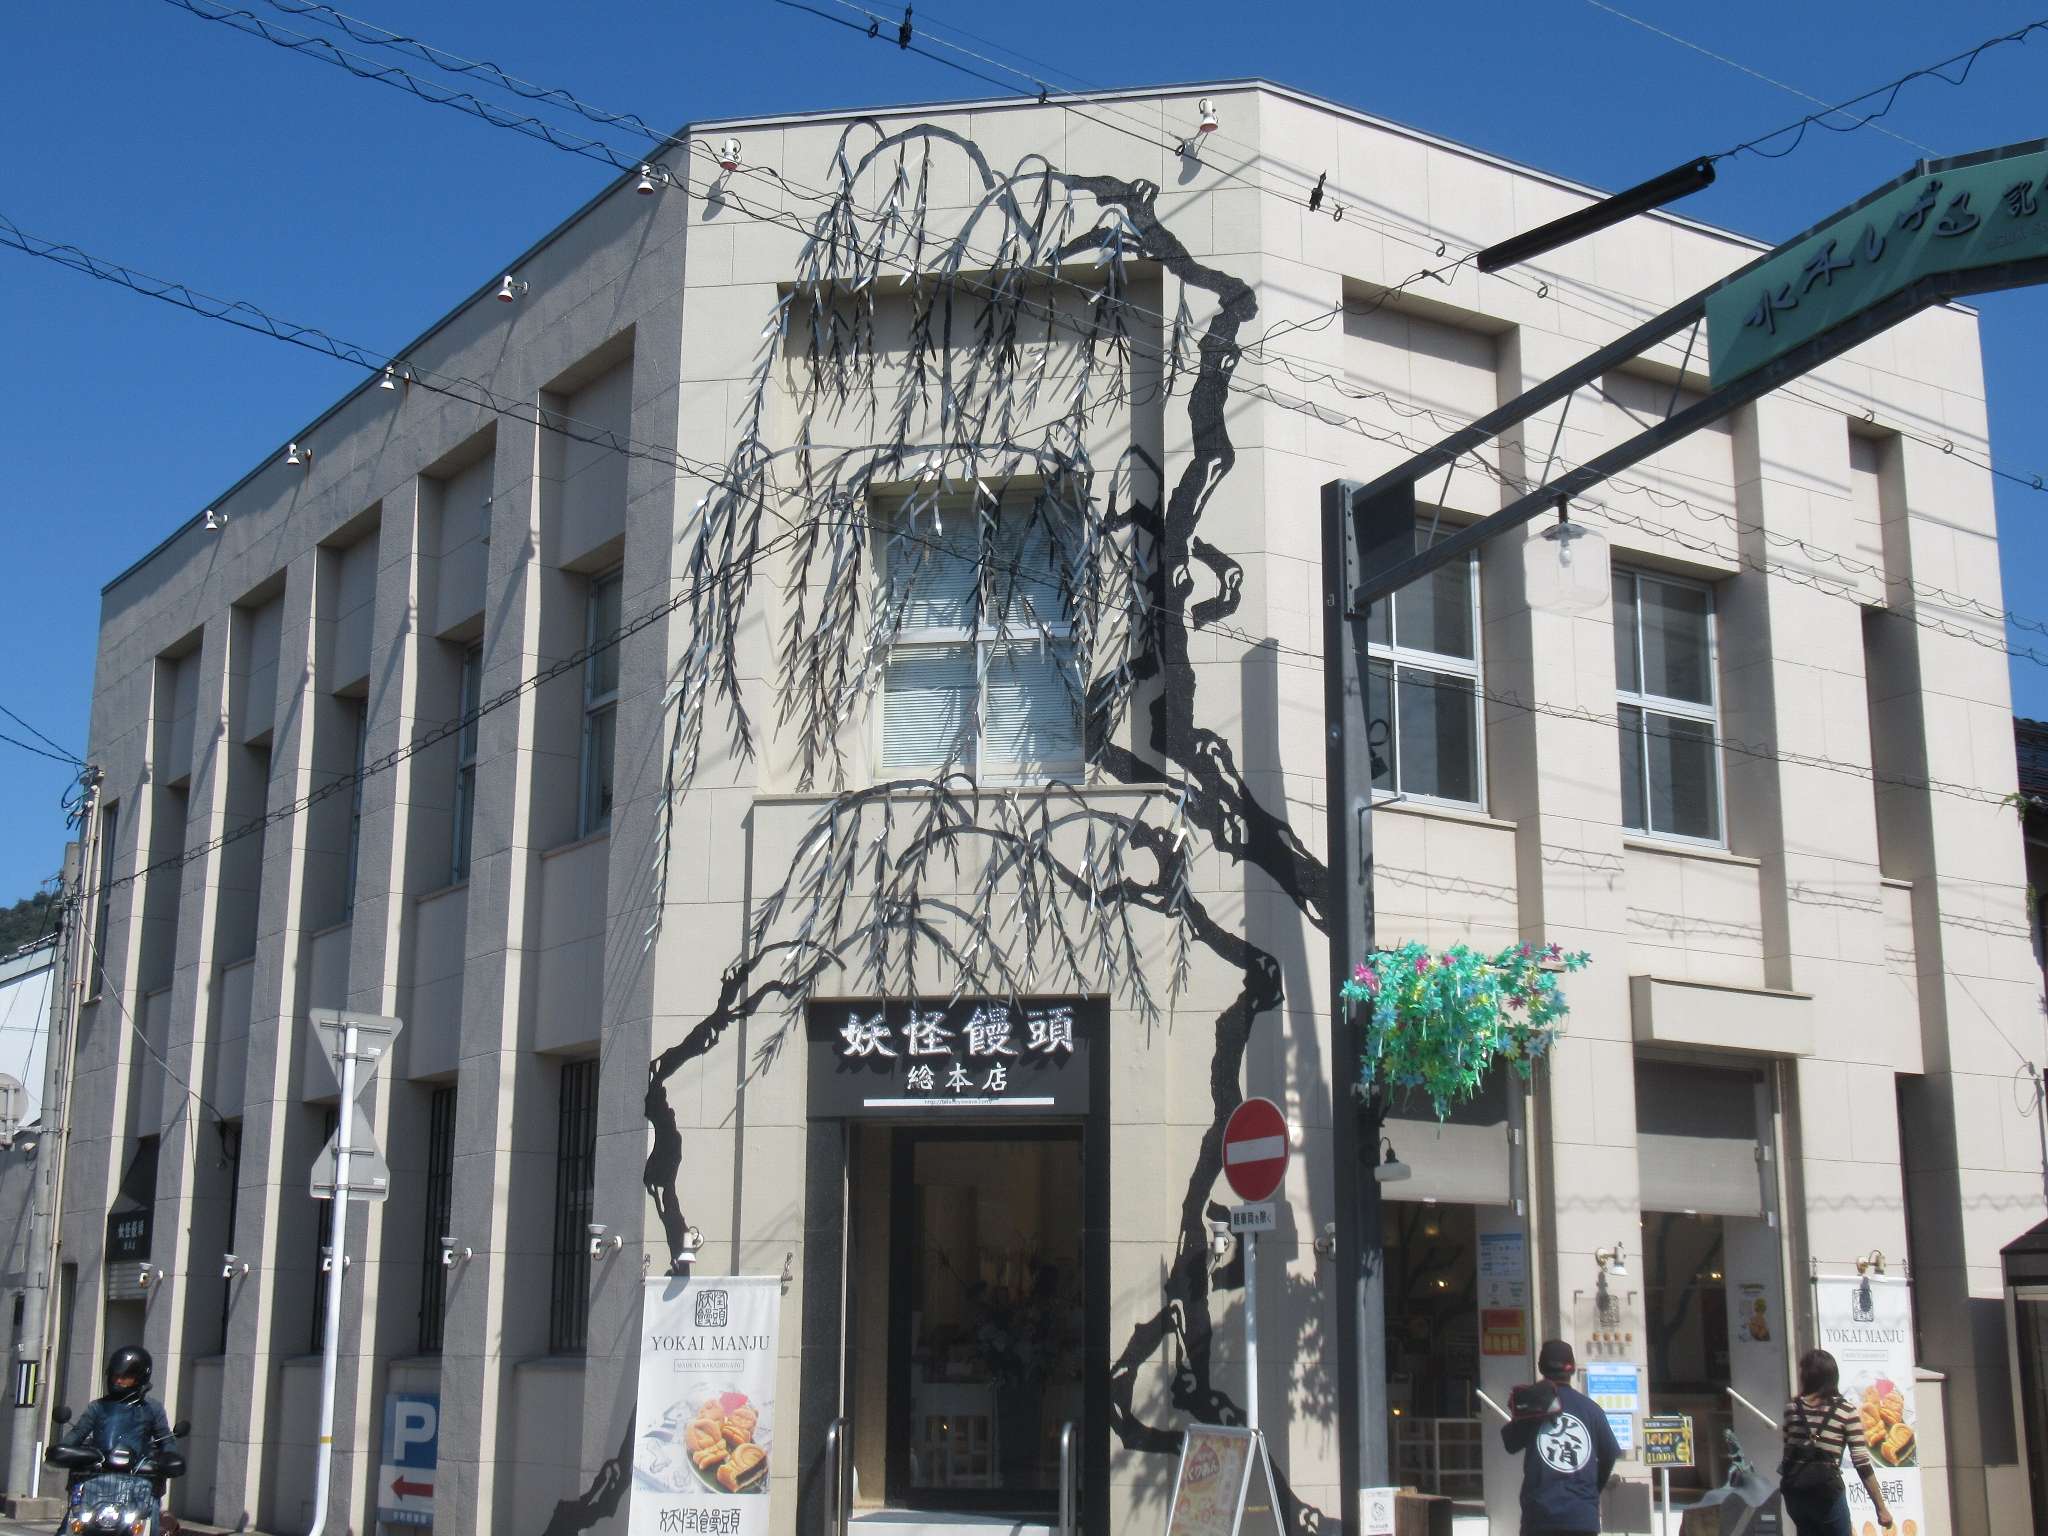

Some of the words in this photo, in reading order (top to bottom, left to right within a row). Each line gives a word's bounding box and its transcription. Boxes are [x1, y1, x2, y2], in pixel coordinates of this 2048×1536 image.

[839, 1006, 1076, 1057] 妖怪饅頭
[907, 1062, 1009, 1093] 総本店
[651, 1335, 704, 1351] YOKAI
[711, 1335, 770, 1351] MANJU
[1826, 1328, 1863, 1343] YOKAI
[1865, 1328, 1905, 1343] MANJU
[393, 1401, 437, 1461] P
[659, 1508, 742, 1536] 妖怪饅頭
